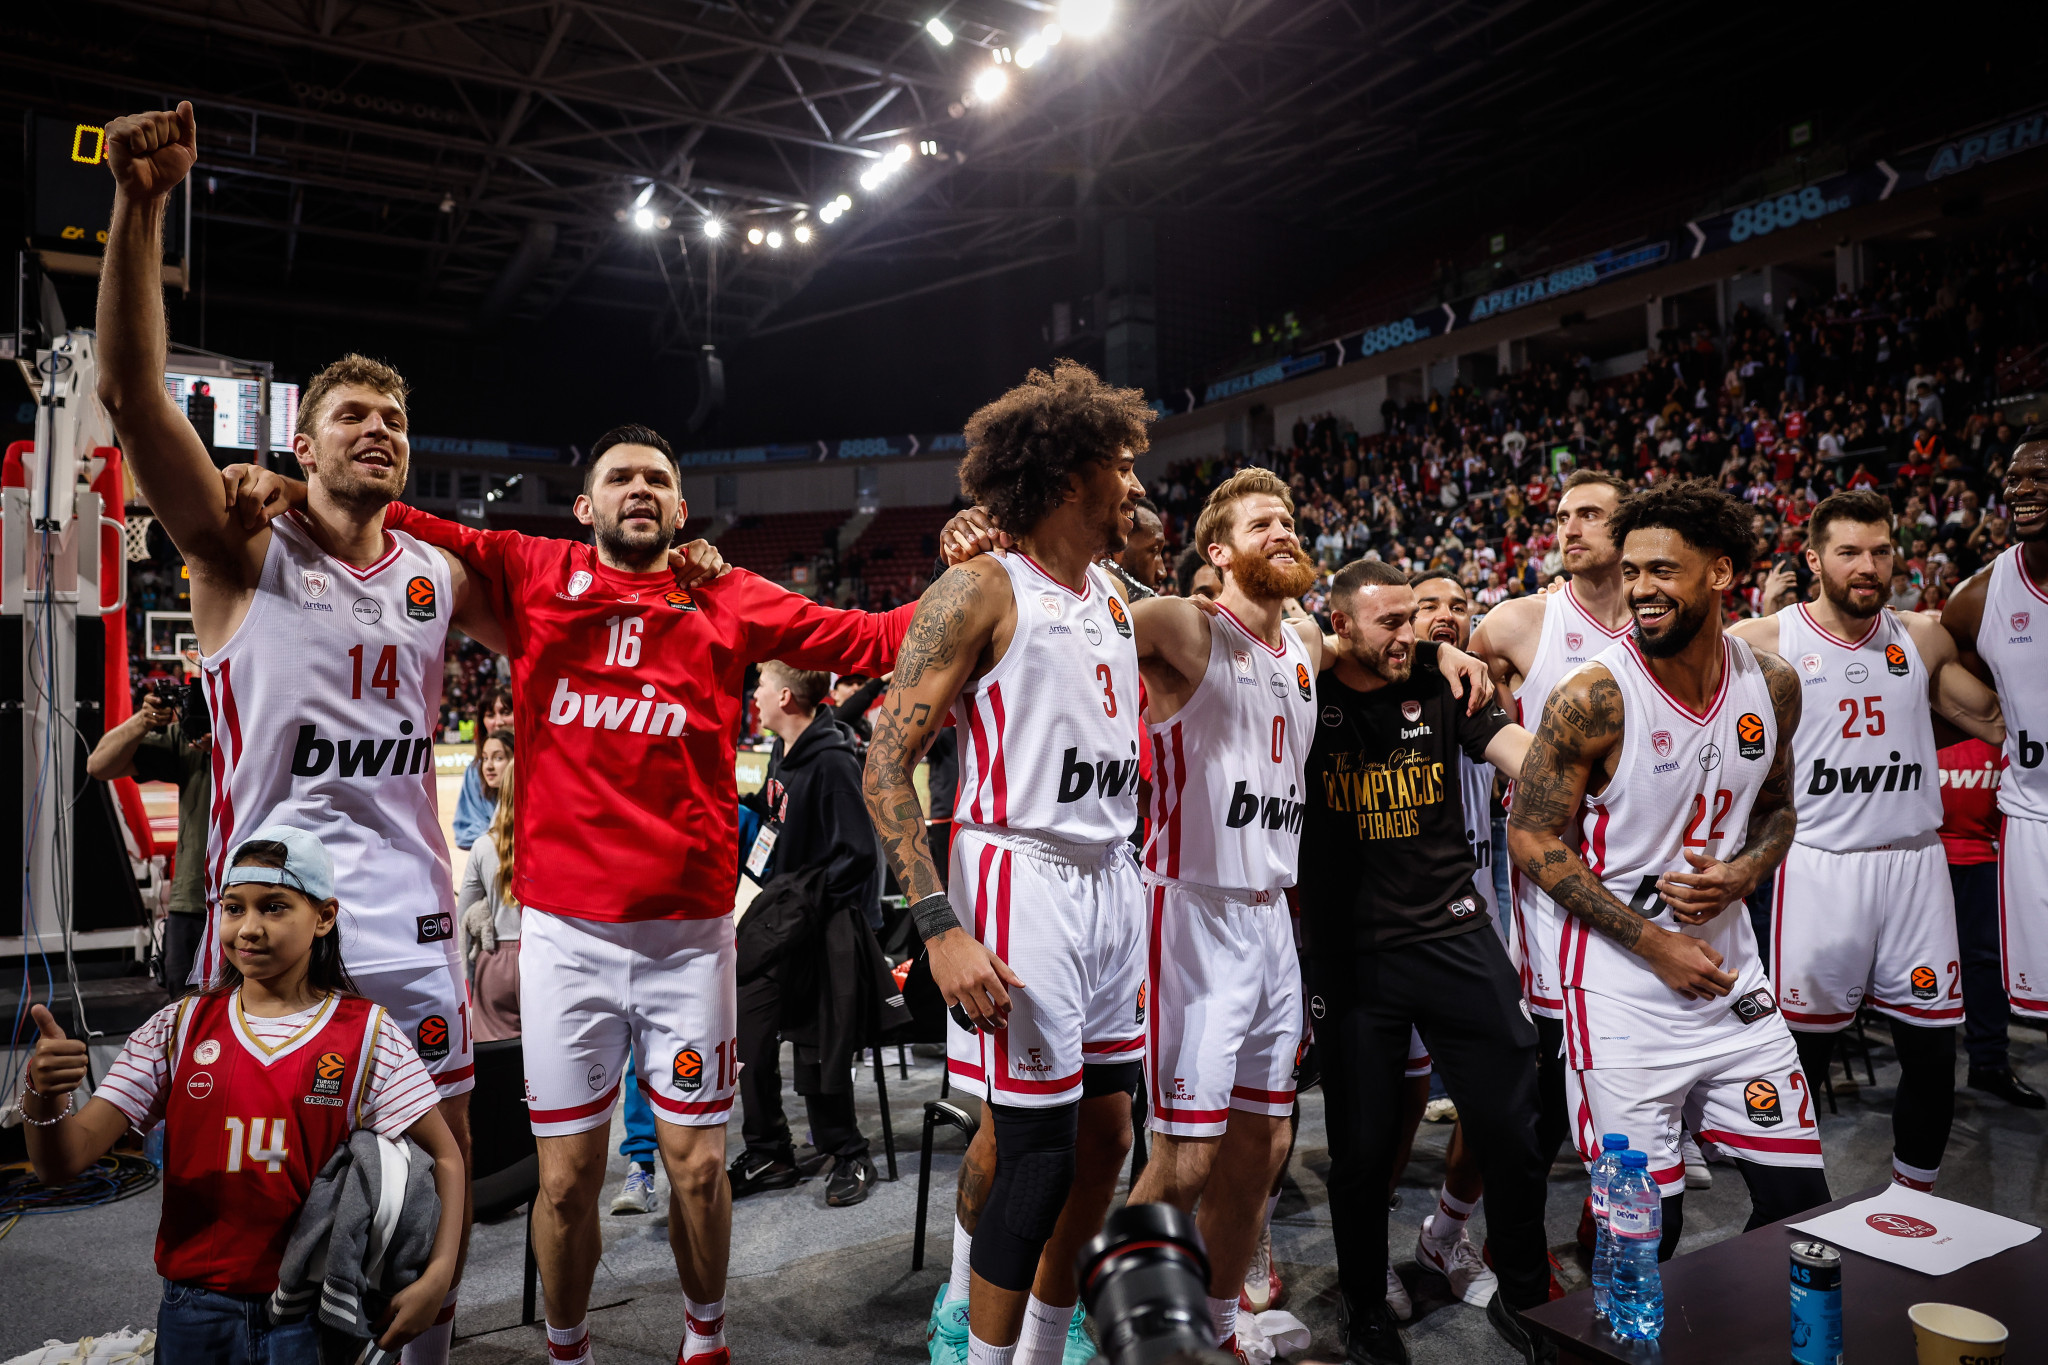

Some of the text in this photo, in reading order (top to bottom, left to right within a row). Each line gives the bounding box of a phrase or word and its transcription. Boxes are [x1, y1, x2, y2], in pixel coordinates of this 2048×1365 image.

[605, 615, 644, 667] 16
[349, 644, 400, 699] 14
[1096, 664, 1117, 718] 3
[549, 678, 687, 737] bwin
[1839, 696, 1885, 739] 25
[290, 720, 431, 777] bwin
[1272, 716, 1285, 764] 0
[1057, 740, 1139, 803] bwi
[1322, 763, 1444, 812] OLYMPIACOS
[1807, 751, 1922, 795] bwin
[1357, 809, 1420, 840] PIRAEUS
[1683, 789, 1733, 847] 22
[1783, 997, 1808, 1007] FlexCar
[458, 1001, 473, 1054] 1
[1018, 1063, 1053, 1071] FlexCar
[1165, 1092, 1195, 1100] FlexCar
[225, 1116, 288, 1173] 14
[1617, 1210, 1639, 1220] DEVIN
